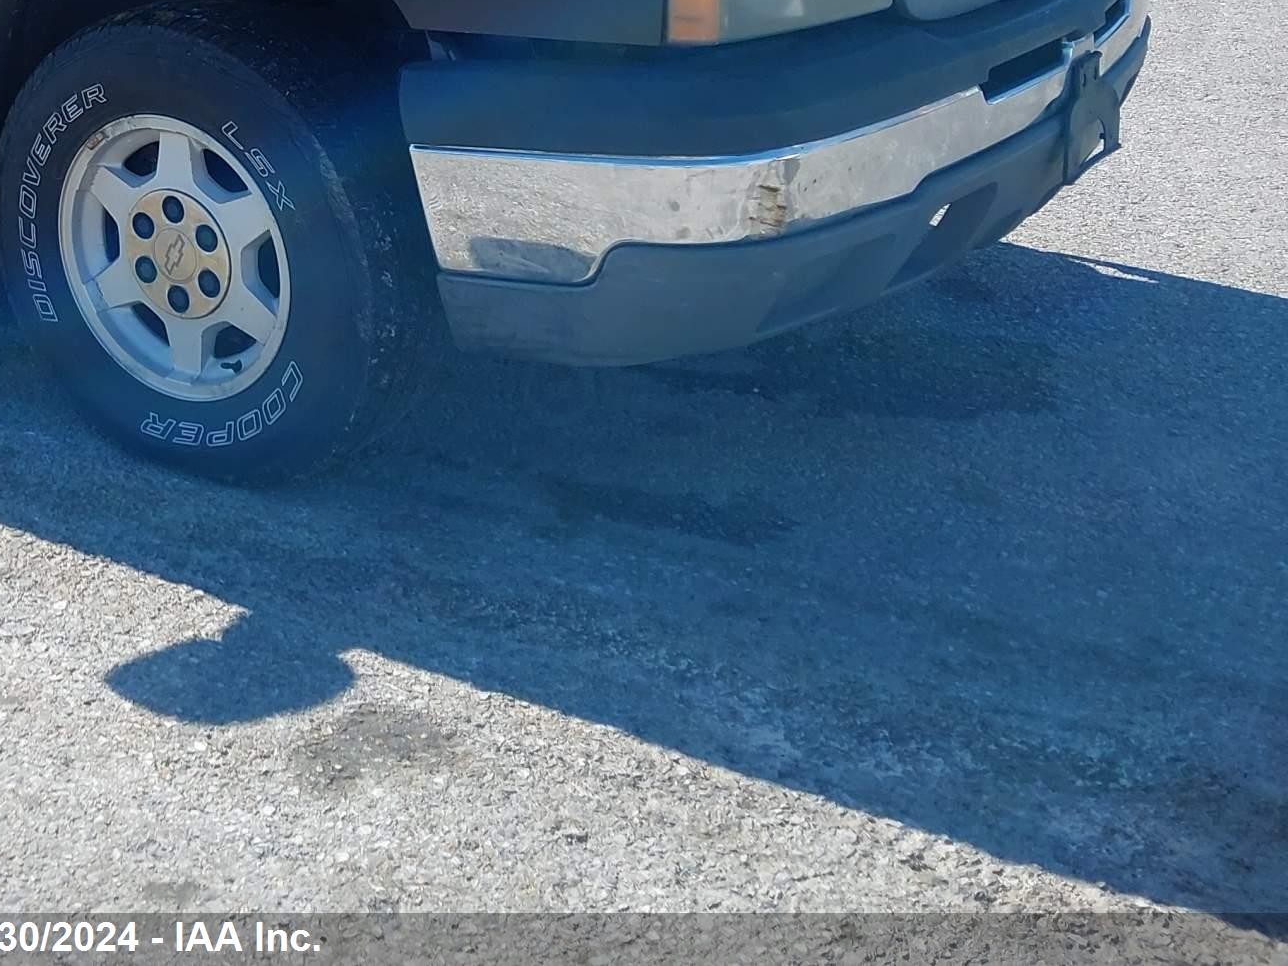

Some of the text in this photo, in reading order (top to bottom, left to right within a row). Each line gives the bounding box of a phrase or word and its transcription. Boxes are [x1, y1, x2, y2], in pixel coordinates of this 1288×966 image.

[17, 82, 108, 323] DISCOVERER
[220, 120, 296, 211] LSX
[140, 360, 304, 448] COOPER
